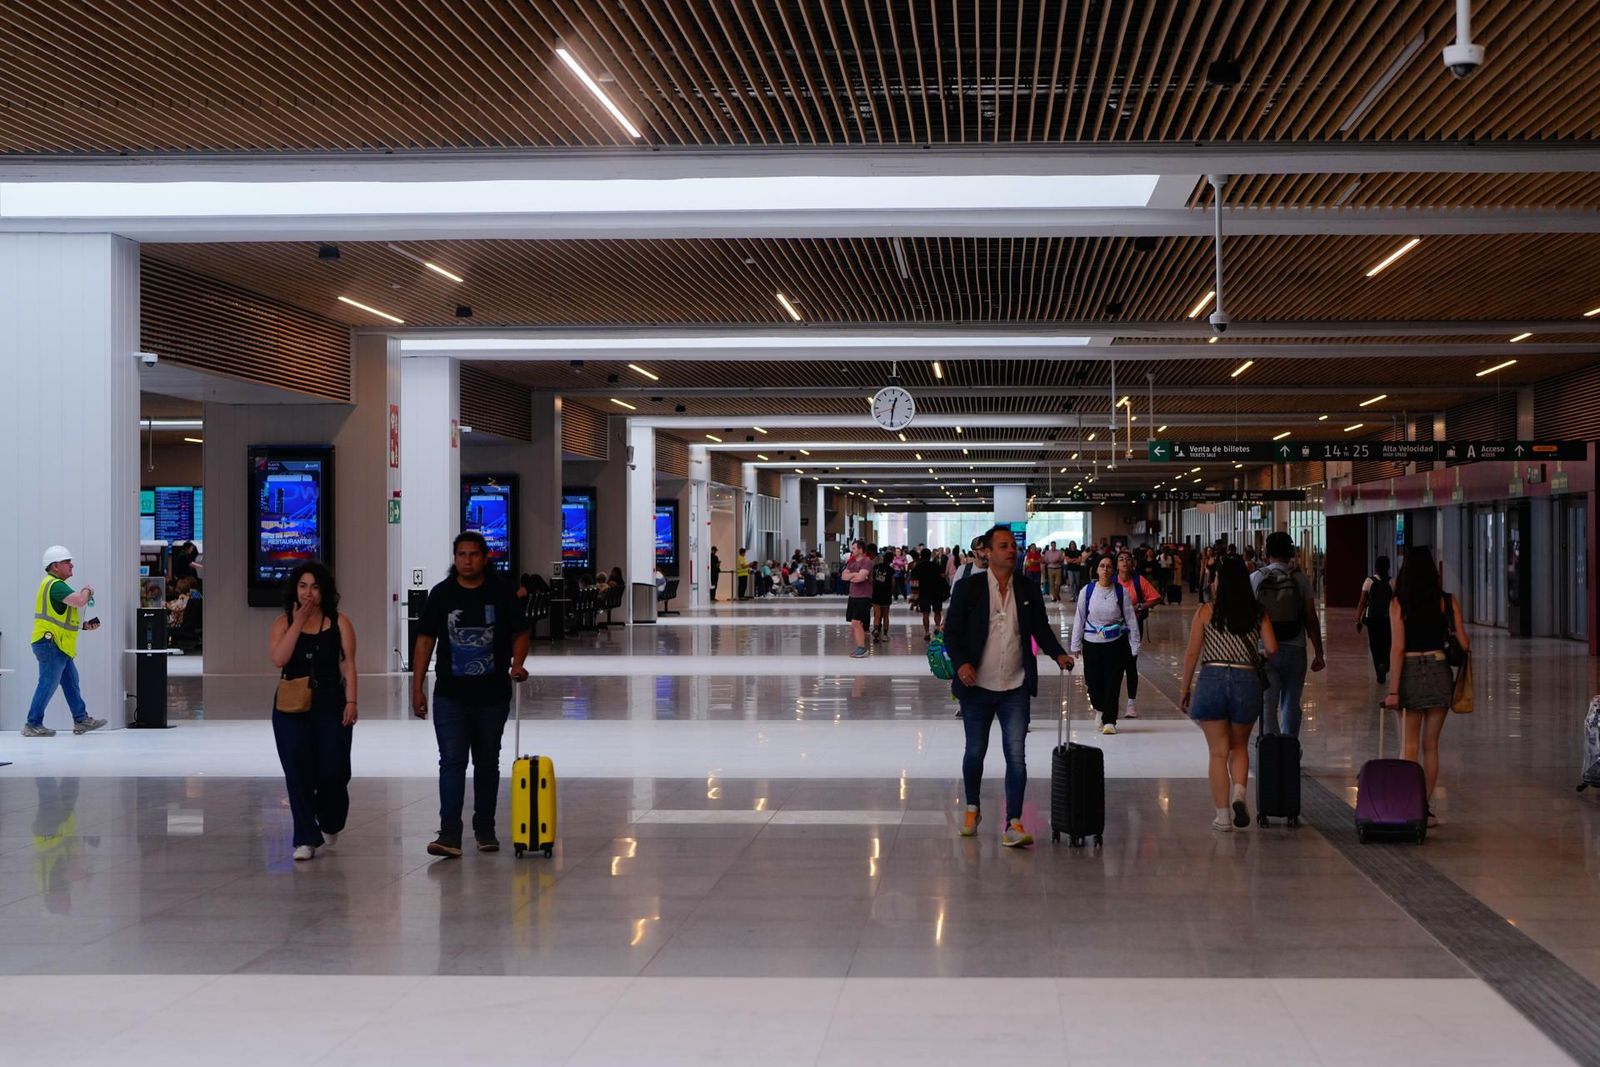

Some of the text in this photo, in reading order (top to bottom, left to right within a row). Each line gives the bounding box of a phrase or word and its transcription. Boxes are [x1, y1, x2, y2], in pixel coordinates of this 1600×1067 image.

[1189, 445, 1250, 453] Venta de billetes
[1324, 444, 1341, 457] 14
[1353, 444, 1369, 457] 25
[1399, 444, 1433, 452] Velocidad
[1467, 444, 1476, 458] A
[1481, 445, 1505, 453] Acceso
